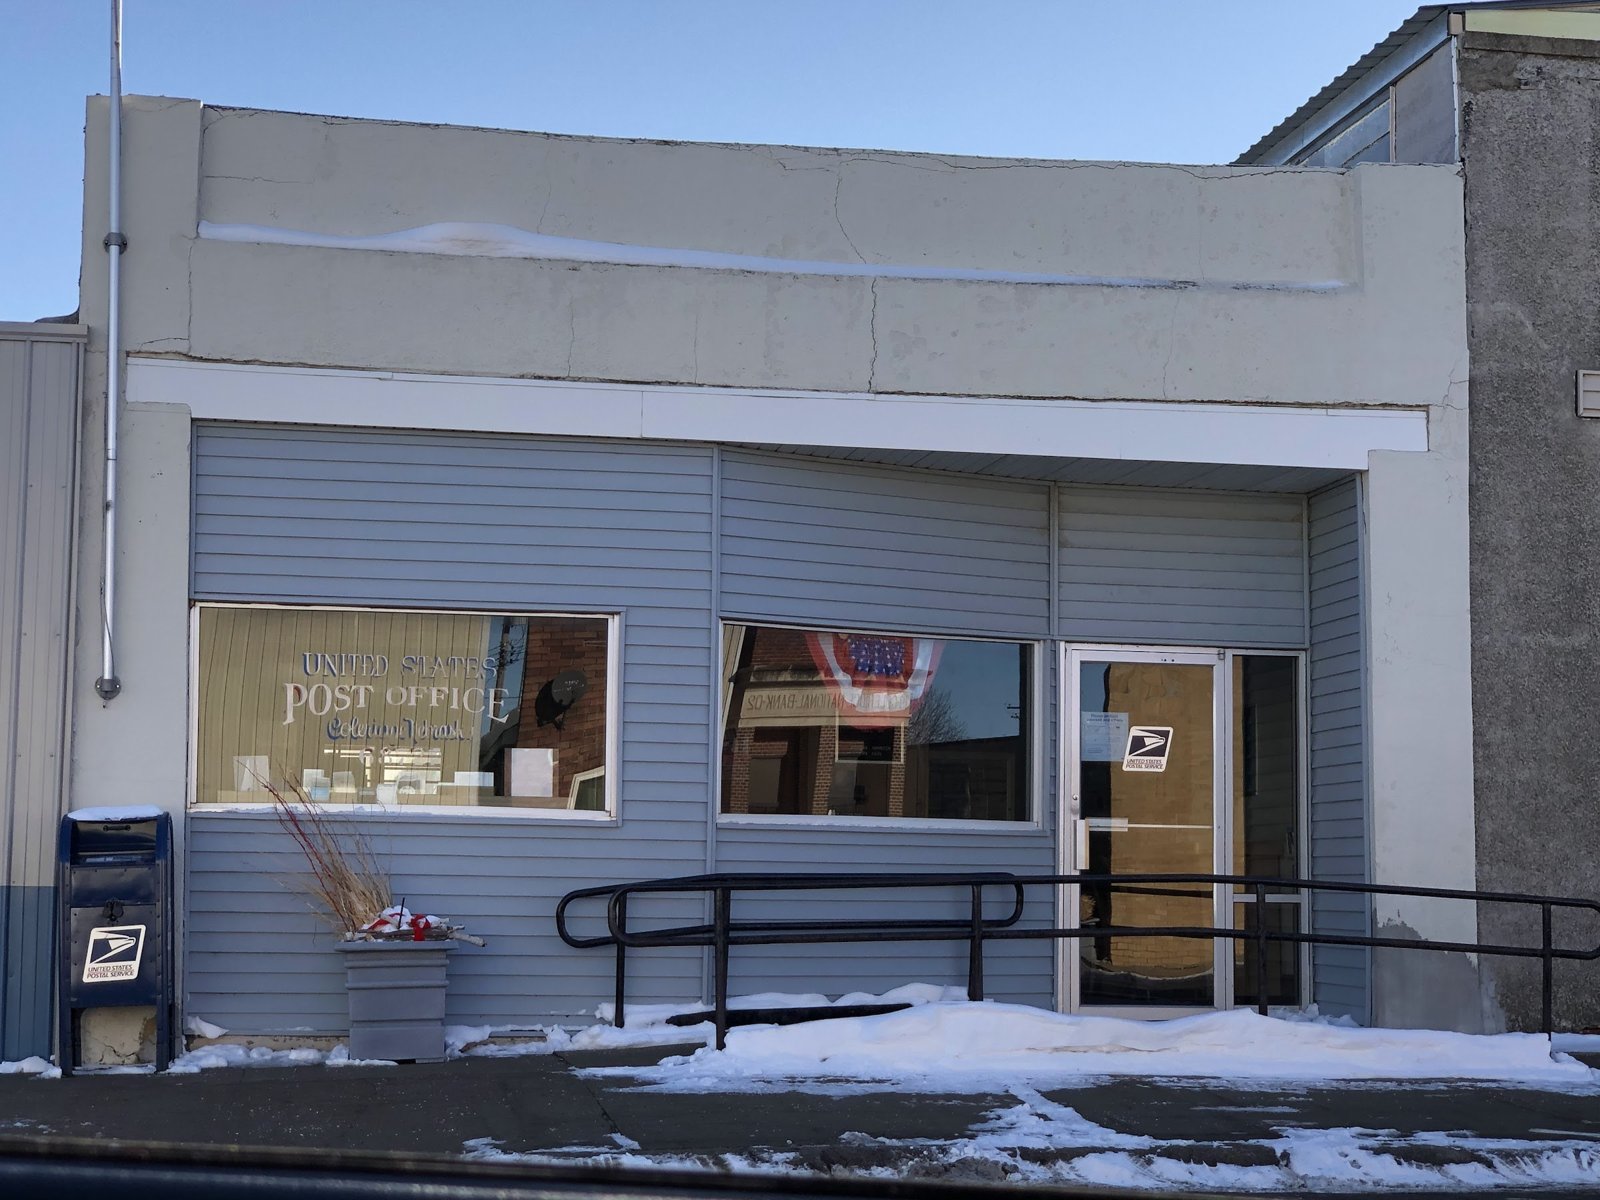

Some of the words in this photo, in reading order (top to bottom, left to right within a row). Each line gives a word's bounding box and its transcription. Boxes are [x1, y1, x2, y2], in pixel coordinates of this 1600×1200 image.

[302, 652, 388, 677] UNITED
[401, 655, 497, 680] STATES
[282, 682, 374, 725] POST
[386, 686, 510, 723] OFFICE
